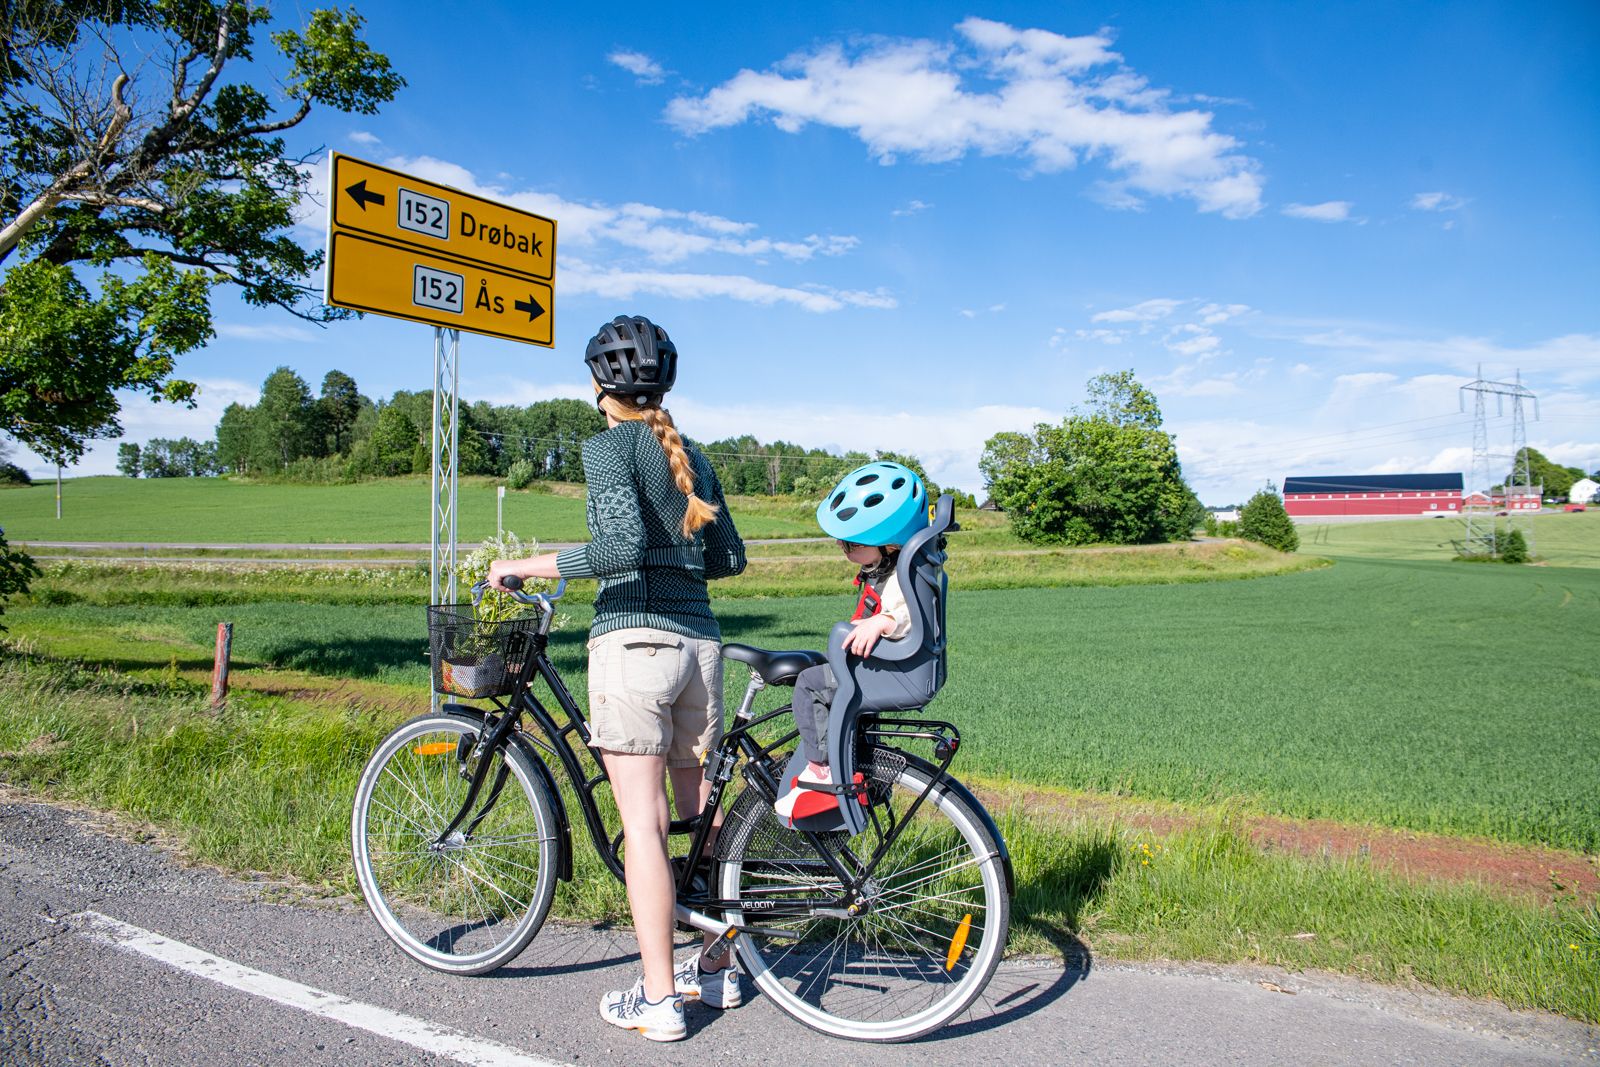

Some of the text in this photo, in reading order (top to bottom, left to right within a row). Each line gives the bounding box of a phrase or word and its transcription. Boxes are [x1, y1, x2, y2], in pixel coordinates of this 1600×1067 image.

[405, 199, 543, 258] 152 Drøbak
[420, 275, 505, 314] 152 Ås
[740, 901, 775, 909] VELOCITY
